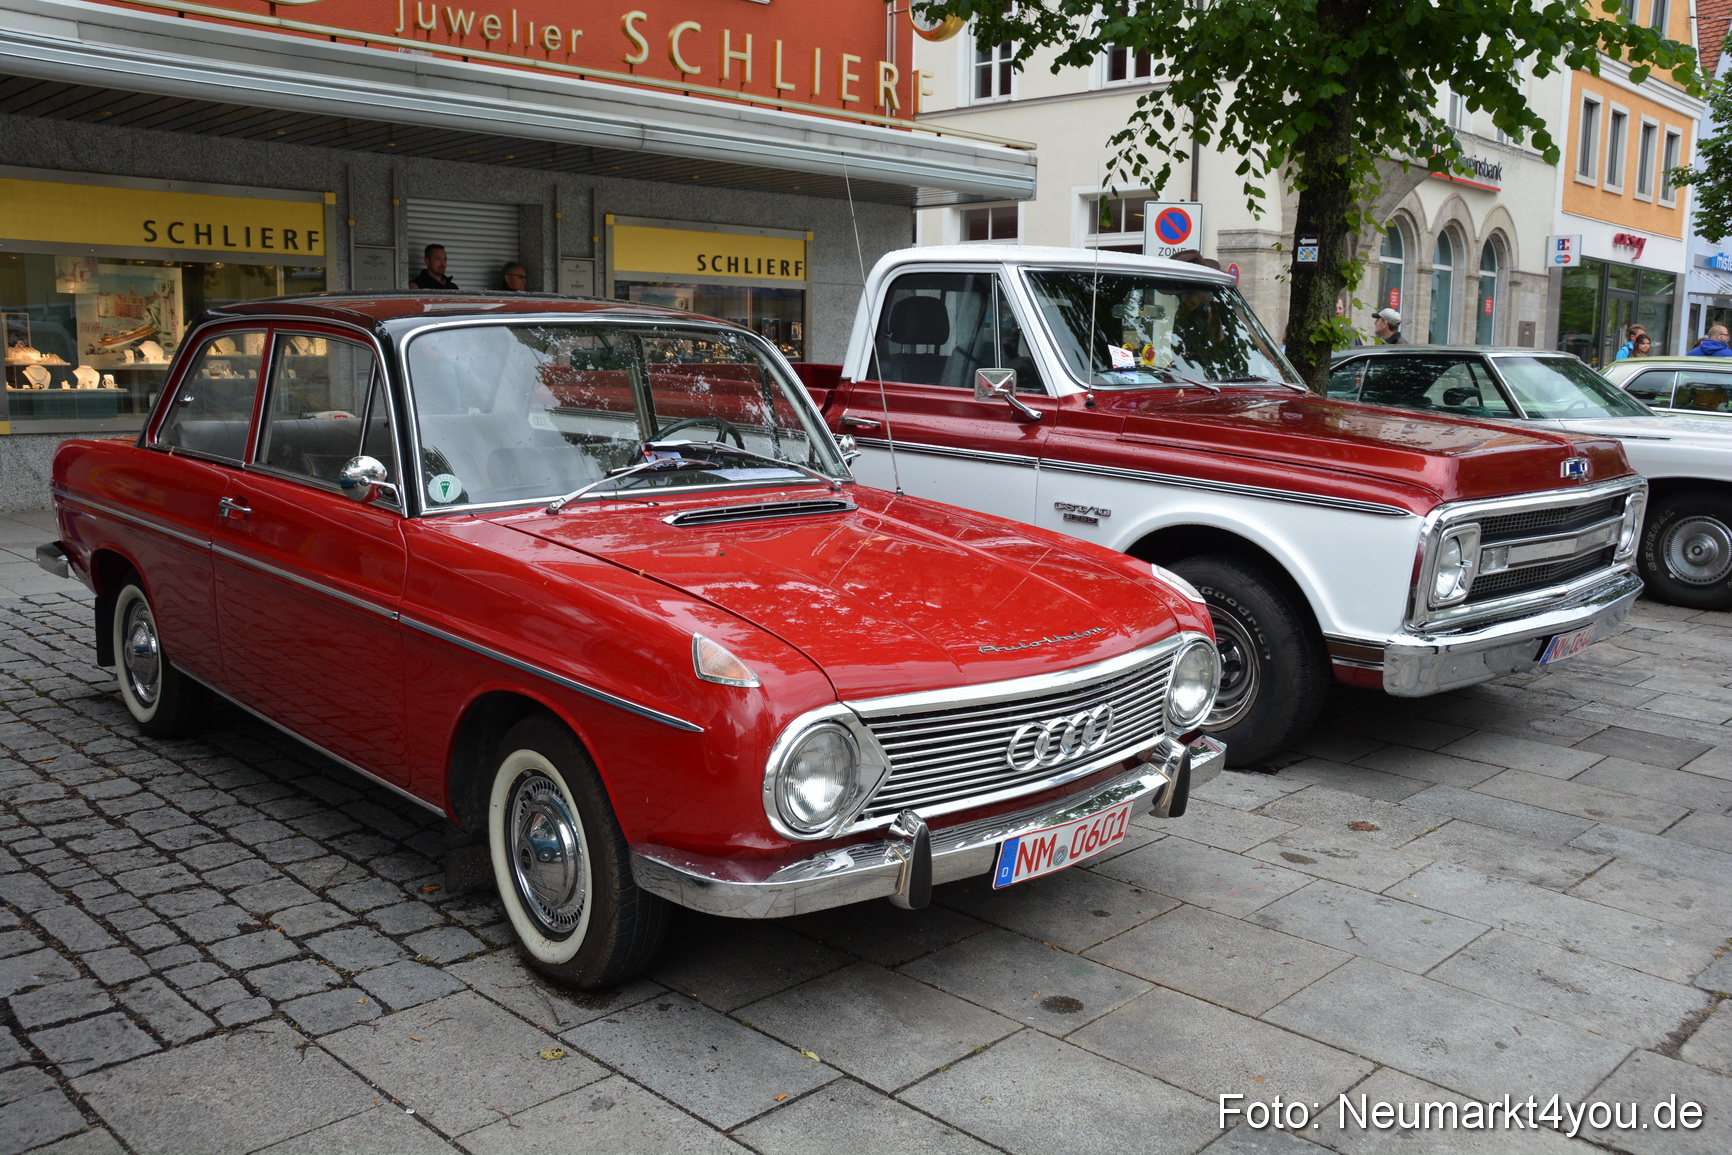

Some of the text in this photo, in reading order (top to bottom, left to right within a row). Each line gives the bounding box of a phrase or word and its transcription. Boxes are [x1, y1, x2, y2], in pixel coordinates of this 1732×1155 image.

[621, 10, 934, 114] SCHLIERF
[143, 219, 320, 251] SCHLIERF
[697, 253, 803, 277] SCHLIERF
[1645, 510, 1675, 571] GENERAL
[1014, 833, 1058, 877] NM
[1069, 806, 1128, 860] 0601
